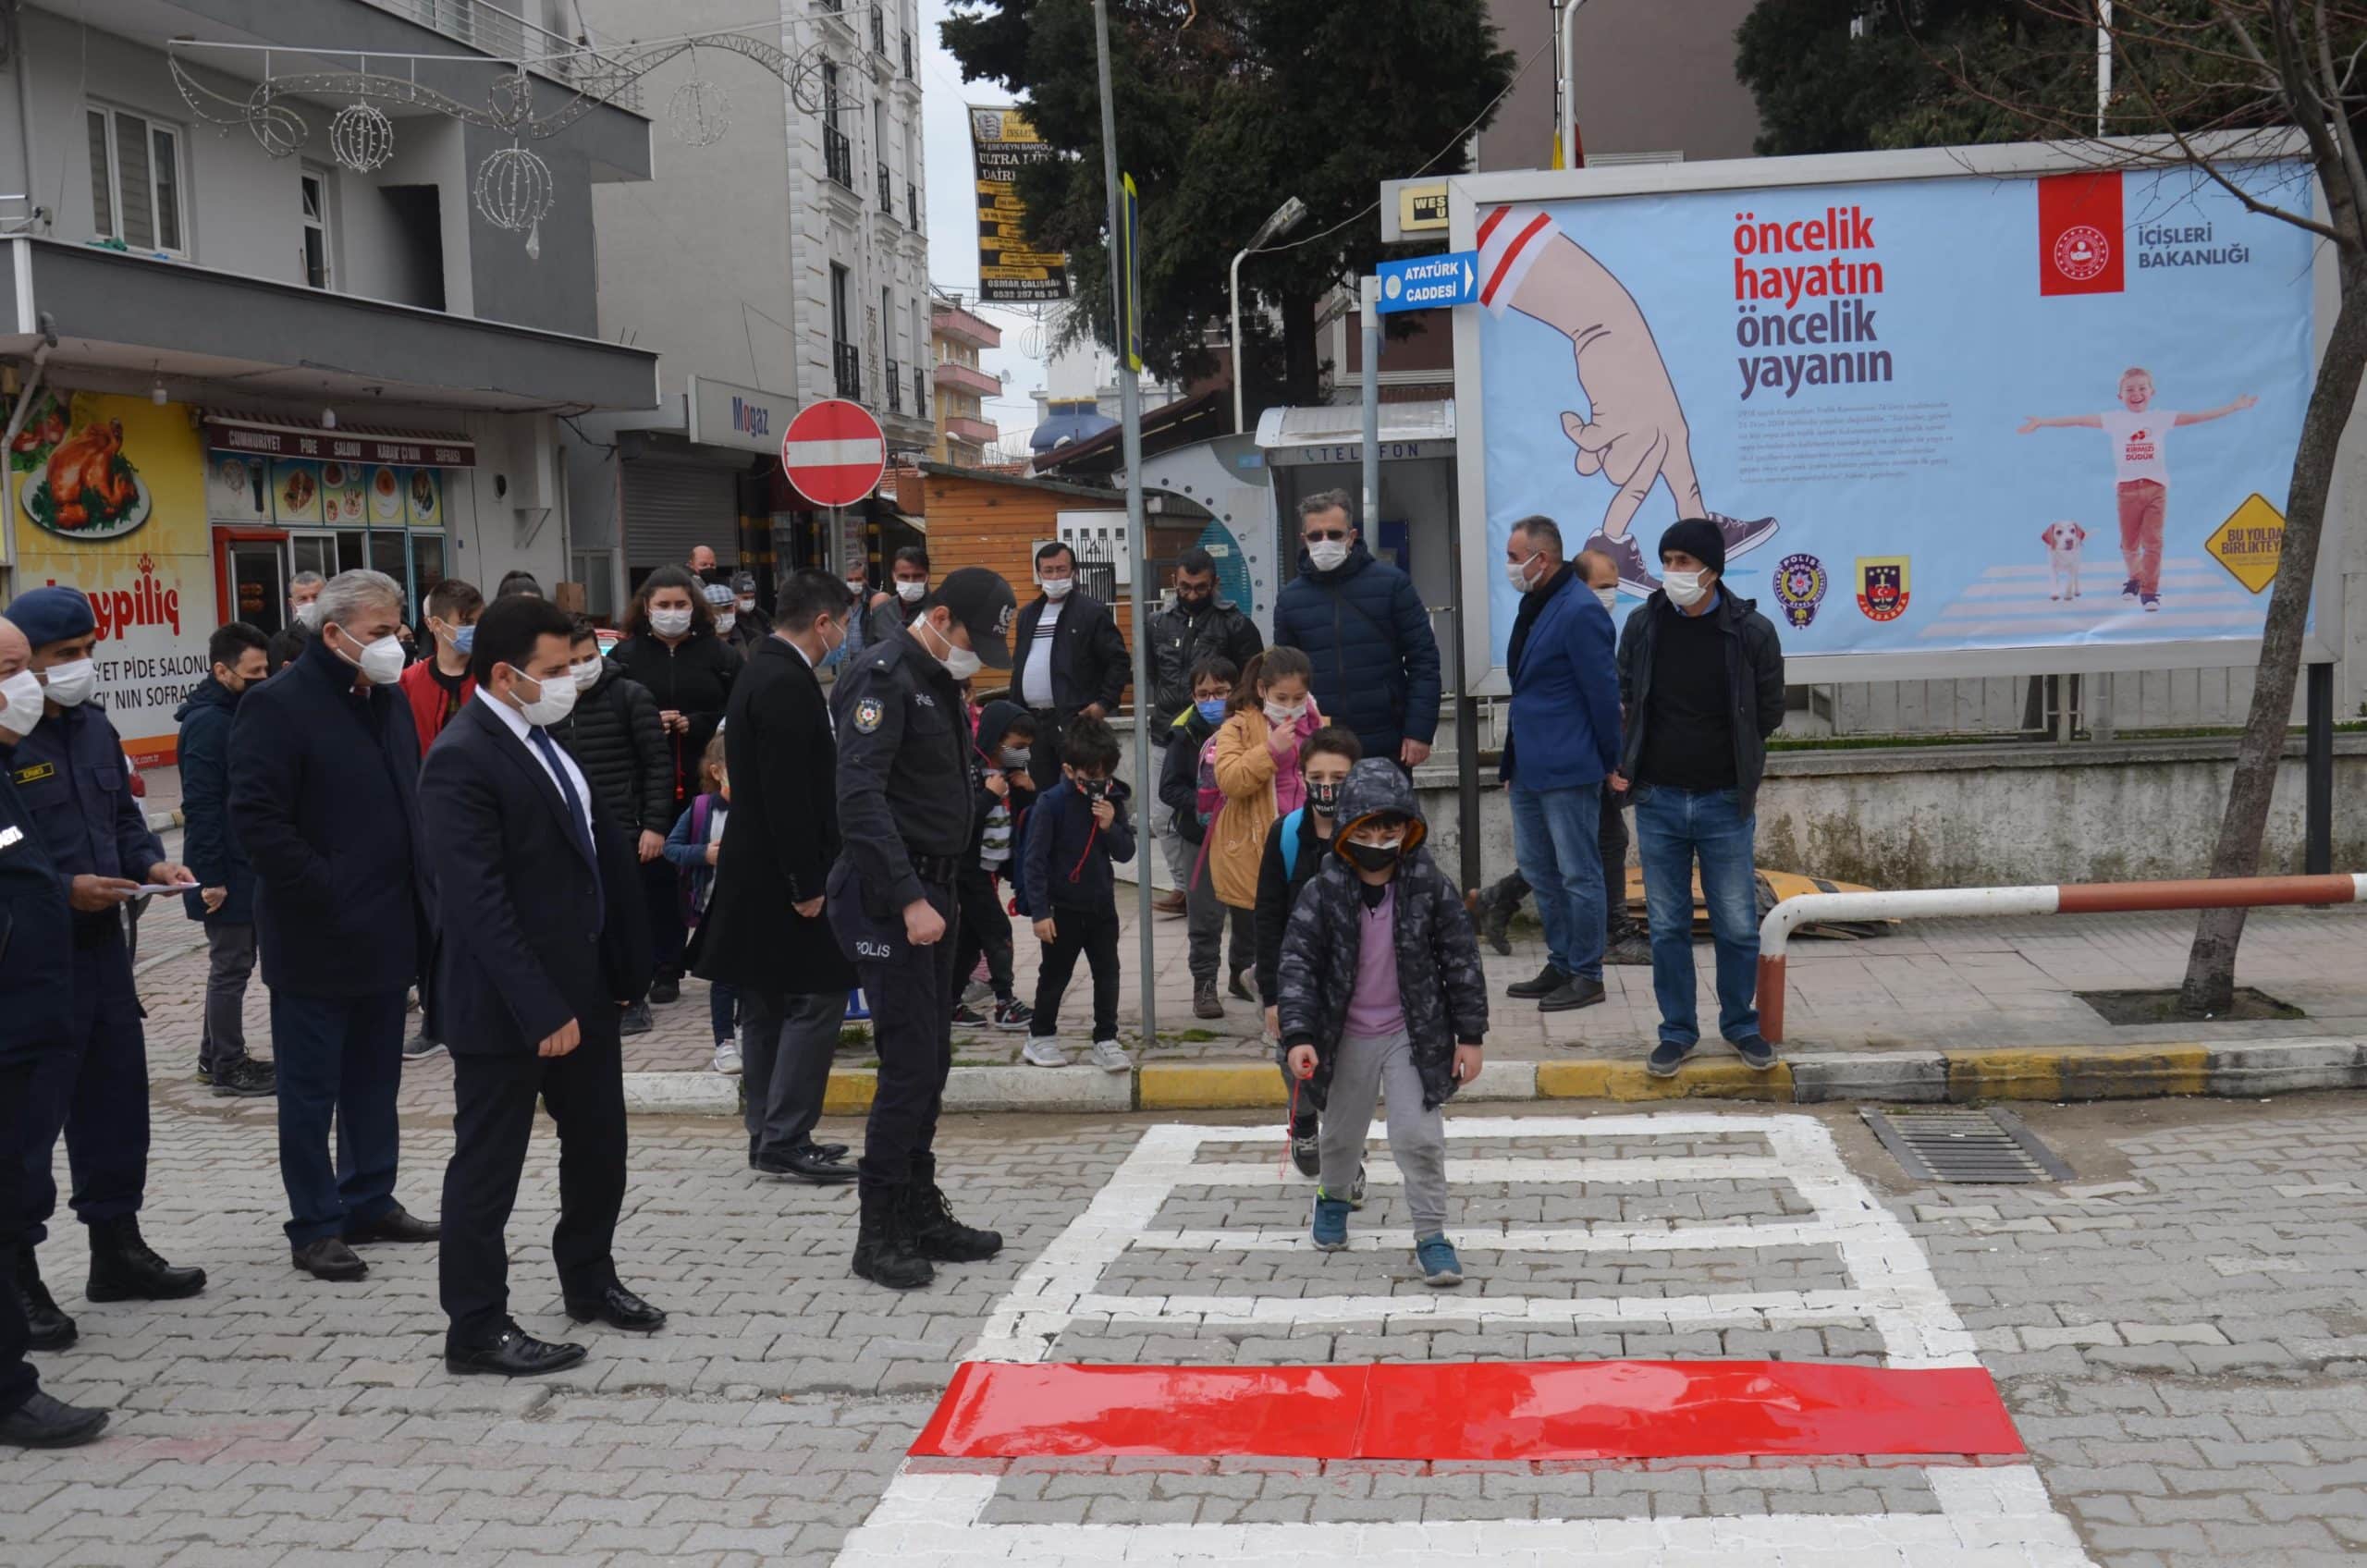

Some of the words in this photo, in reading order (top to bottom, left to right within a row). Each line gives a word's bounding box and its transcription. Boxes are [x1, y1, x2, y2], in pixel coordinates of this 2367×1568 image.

[979, 153, 1019, 165] ULTRA
[1734, 206, 1875, 255] öncelik
[2138, 221, 2213, 250] İÇİŞLERİ
[2138, 242, 2250, 269] BAKANLIĞI
[1404, 260, 1460, 281] ATATÜRK
[1405, 280, 1457, 302] CADDESİ
[1734, 257, 1883, 311] hayatın
[1736, 299, 1878, 348] öncelik
[1738, 350, 1894, 401] yayanın
[732, 396, 769, 437] Mogaz
[333, 441, 362, 459] SALONU
[1320, 443, 1418, 461] TELFON
[2227, 529, 2244, 542] BU
[1783, 556, 1816, 567] POLİS
[124, 656, 155, 680] PİDE
[159, 655, 213, 678] SALONU
[116, 688, 141, 710] NIN
